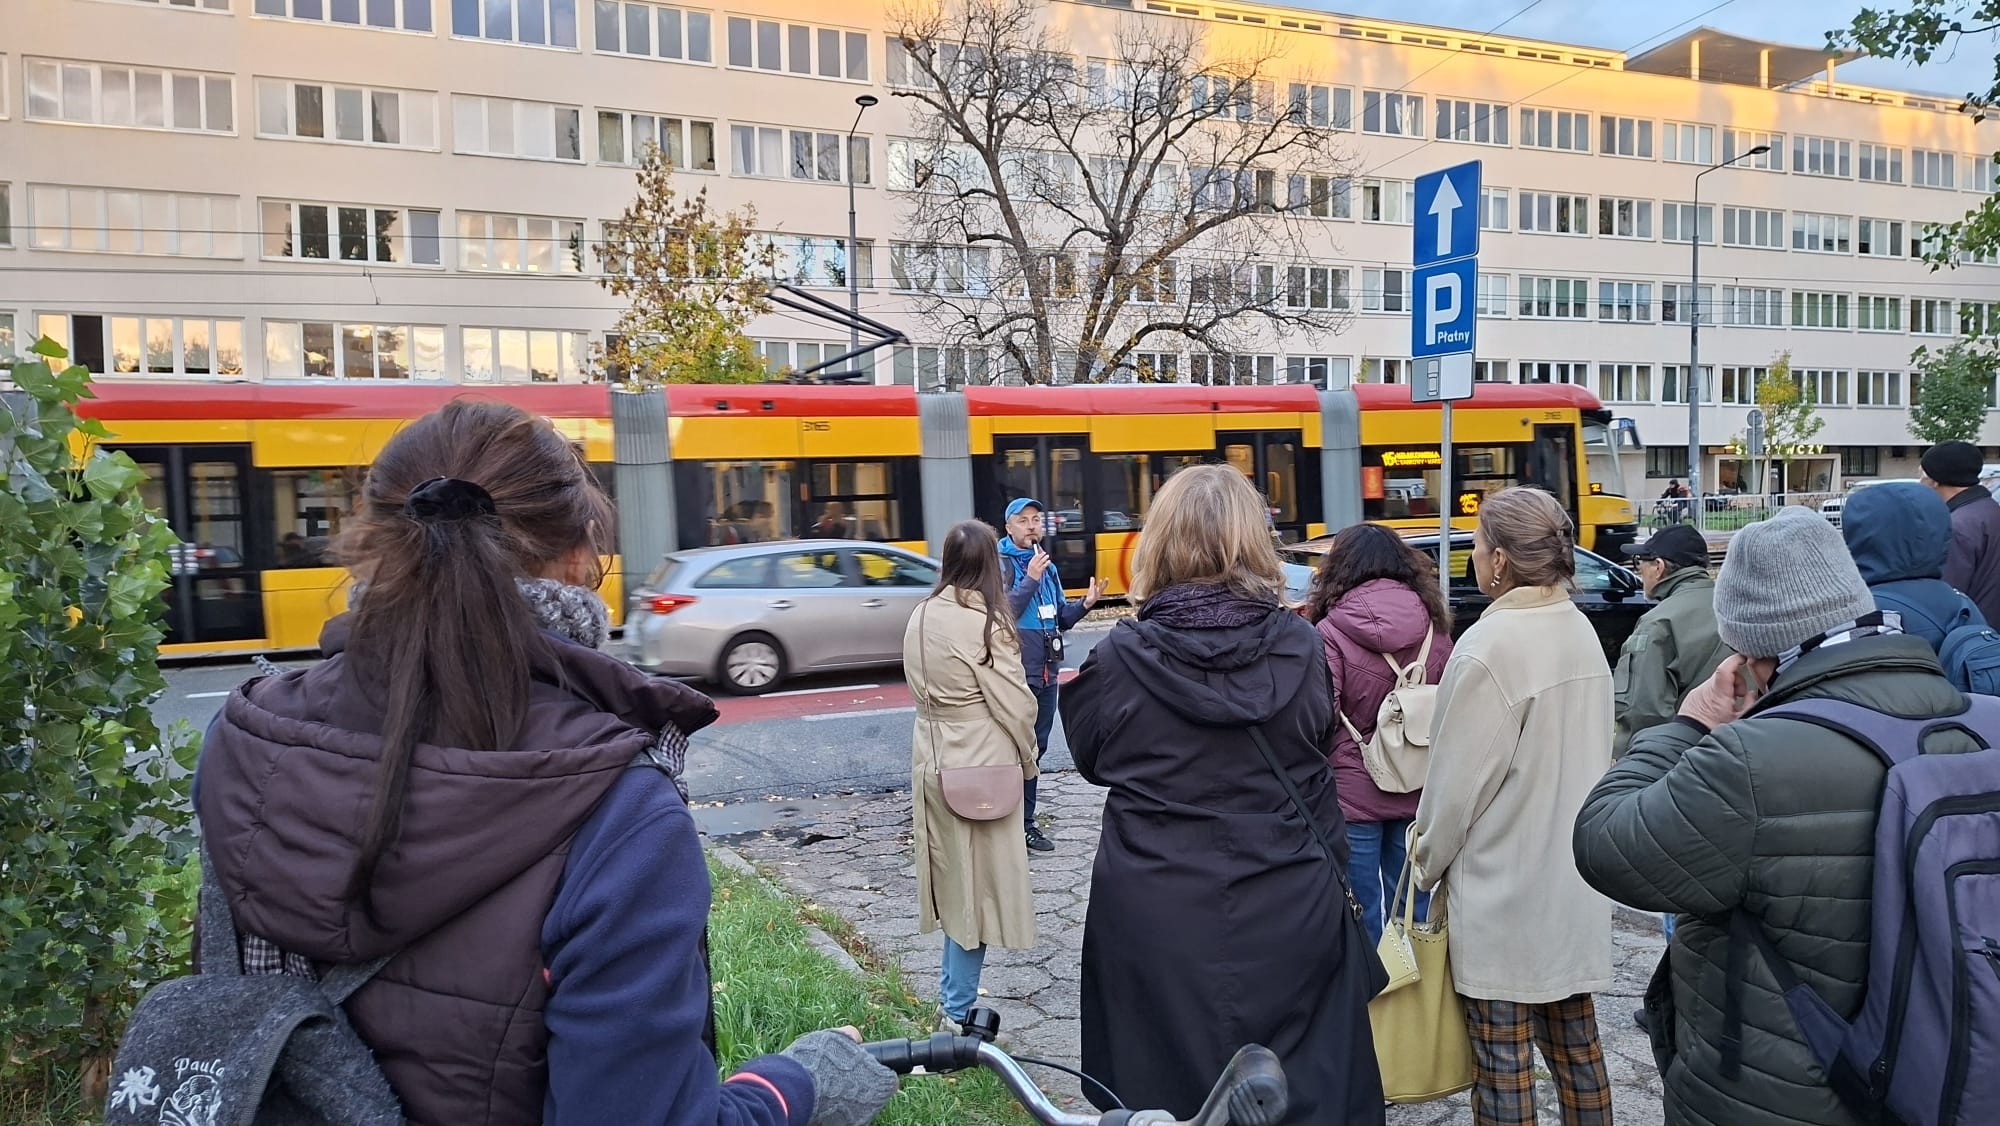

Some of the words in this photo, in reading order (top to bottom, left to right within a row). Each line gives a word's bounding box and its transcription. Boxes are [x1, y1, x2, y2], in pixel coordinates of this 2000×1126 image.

[1426, 272, 1462, 345] P
[1437, 330, 1470, 344] Płatny
[1735, 444, 1824, 455] SYWCZY
[174, 1057, 225, 1080] Paula
